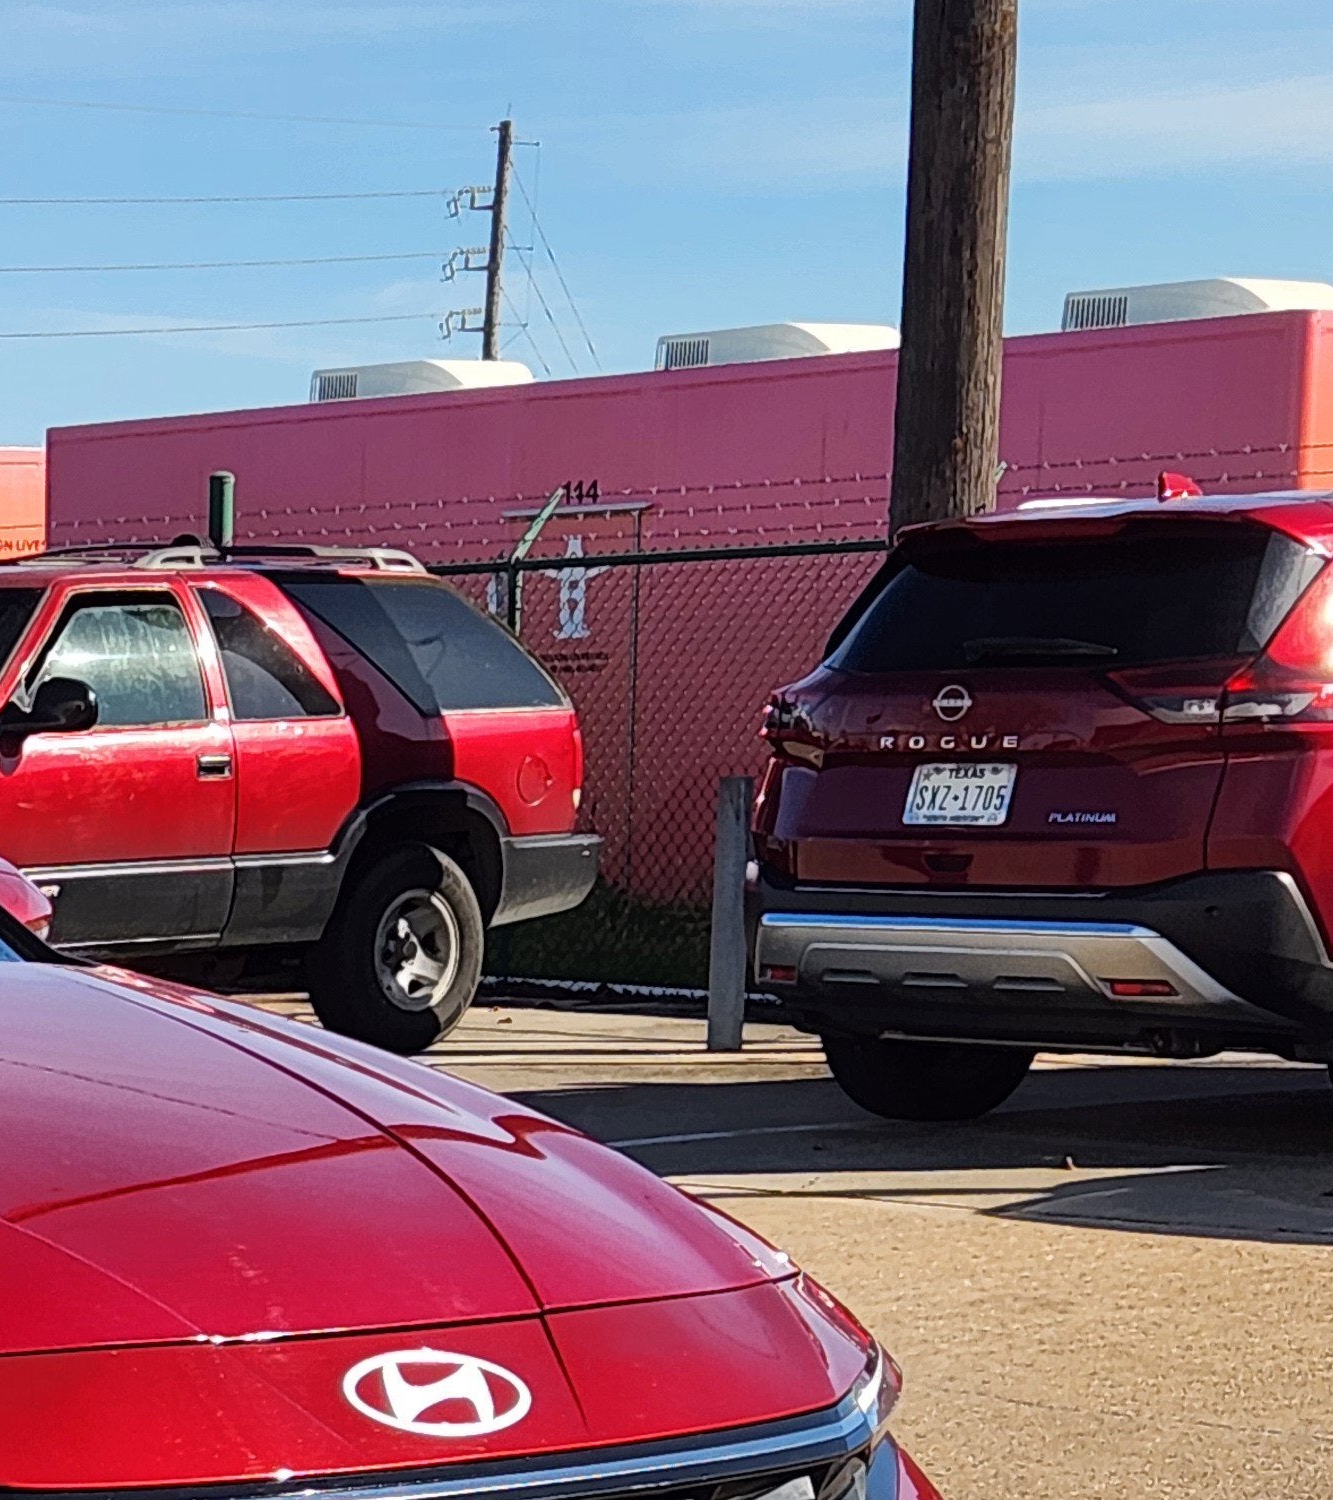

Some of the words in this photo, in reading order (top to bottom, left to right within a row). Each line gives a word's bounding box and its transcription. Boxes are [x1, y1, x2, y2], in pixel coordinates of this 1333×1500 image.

[880, 735, 1019, 750] ROGUE
[948, 768, 987, 779] TEXAS
[1047, 812, 1116, 823] PLATINUM
